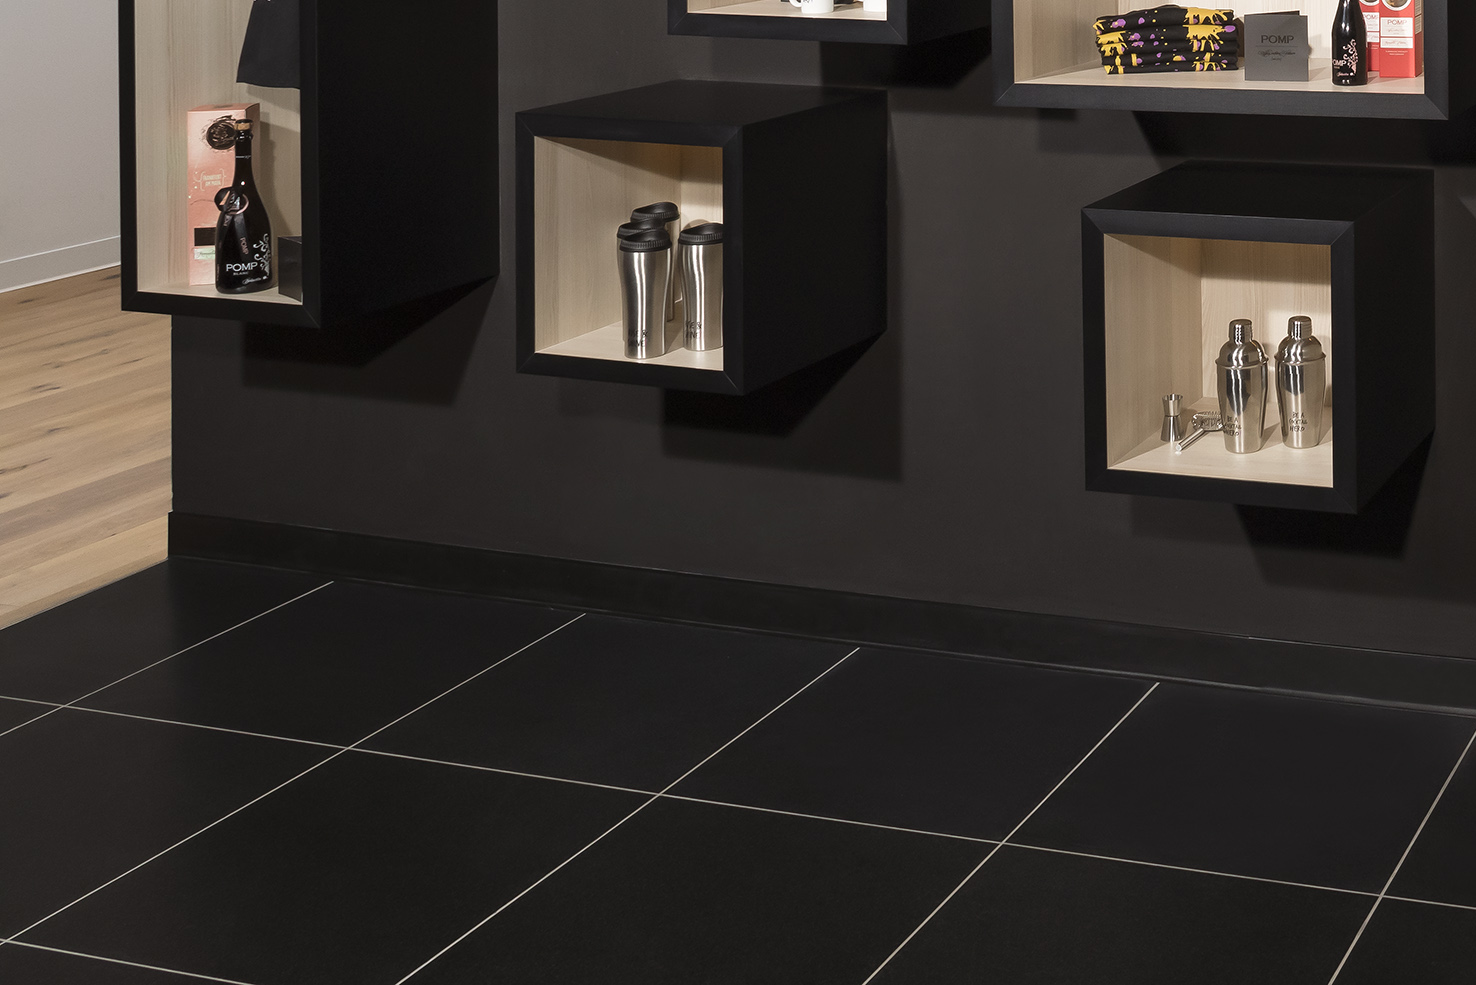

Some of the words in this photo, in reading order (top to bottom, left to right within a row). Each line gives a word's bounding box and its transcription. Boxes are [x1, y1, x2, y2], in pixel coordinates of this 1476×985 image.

[1260, 34, 1294, 44] POMP
[1332, 59, 1347, 67] OMP
[226, 262, 258, 272] POMP
